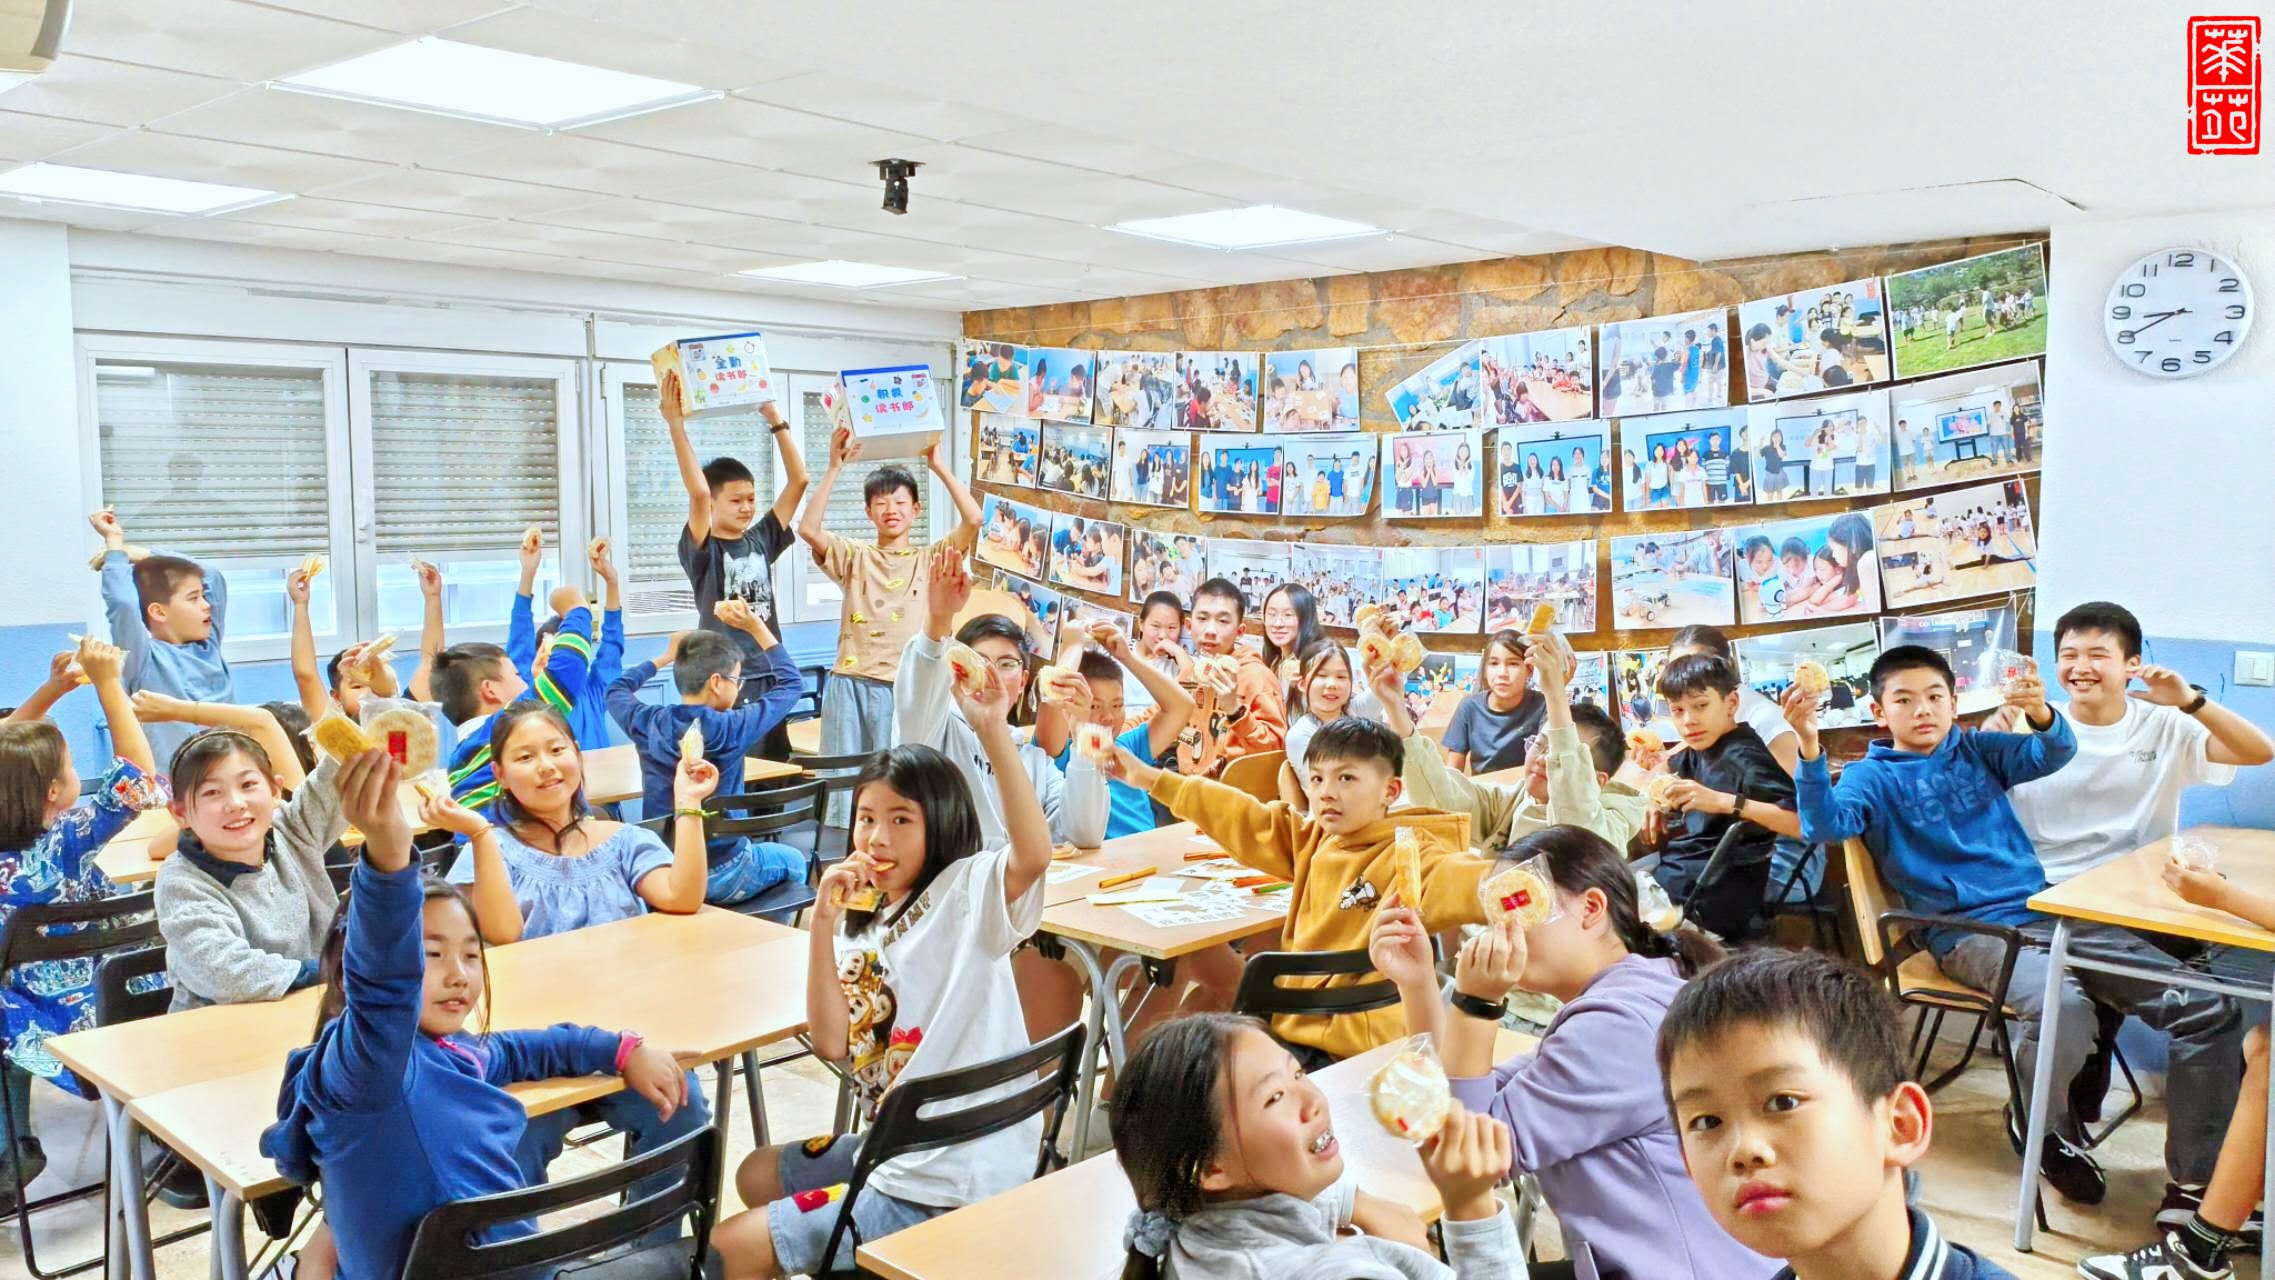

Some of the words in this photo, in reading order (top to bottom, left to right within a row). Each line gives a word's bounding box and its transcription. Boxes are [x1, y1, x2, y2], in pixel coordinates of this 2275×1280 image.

[2168, 253, 2194, 267] 12
[2210, 259, 2215, 272] 1
[2143, 264, 2158, 277] 11
[2121, 283, 2146, 298] 10
[2218, 278, 2239, 292] 2
[2112, 306, 2131, 320] 9
[2224, 305, 2245, 319] 3
[2117, 330, 2136, 344] 8
[2214, 330, 2234, 344] 4
[2134, 350, 2153, 363] 7
[2192, 350, 2211, 364] 5
[2161, 357, 2181, 372] 6
[875, 401, 914, 413] 读书郎
